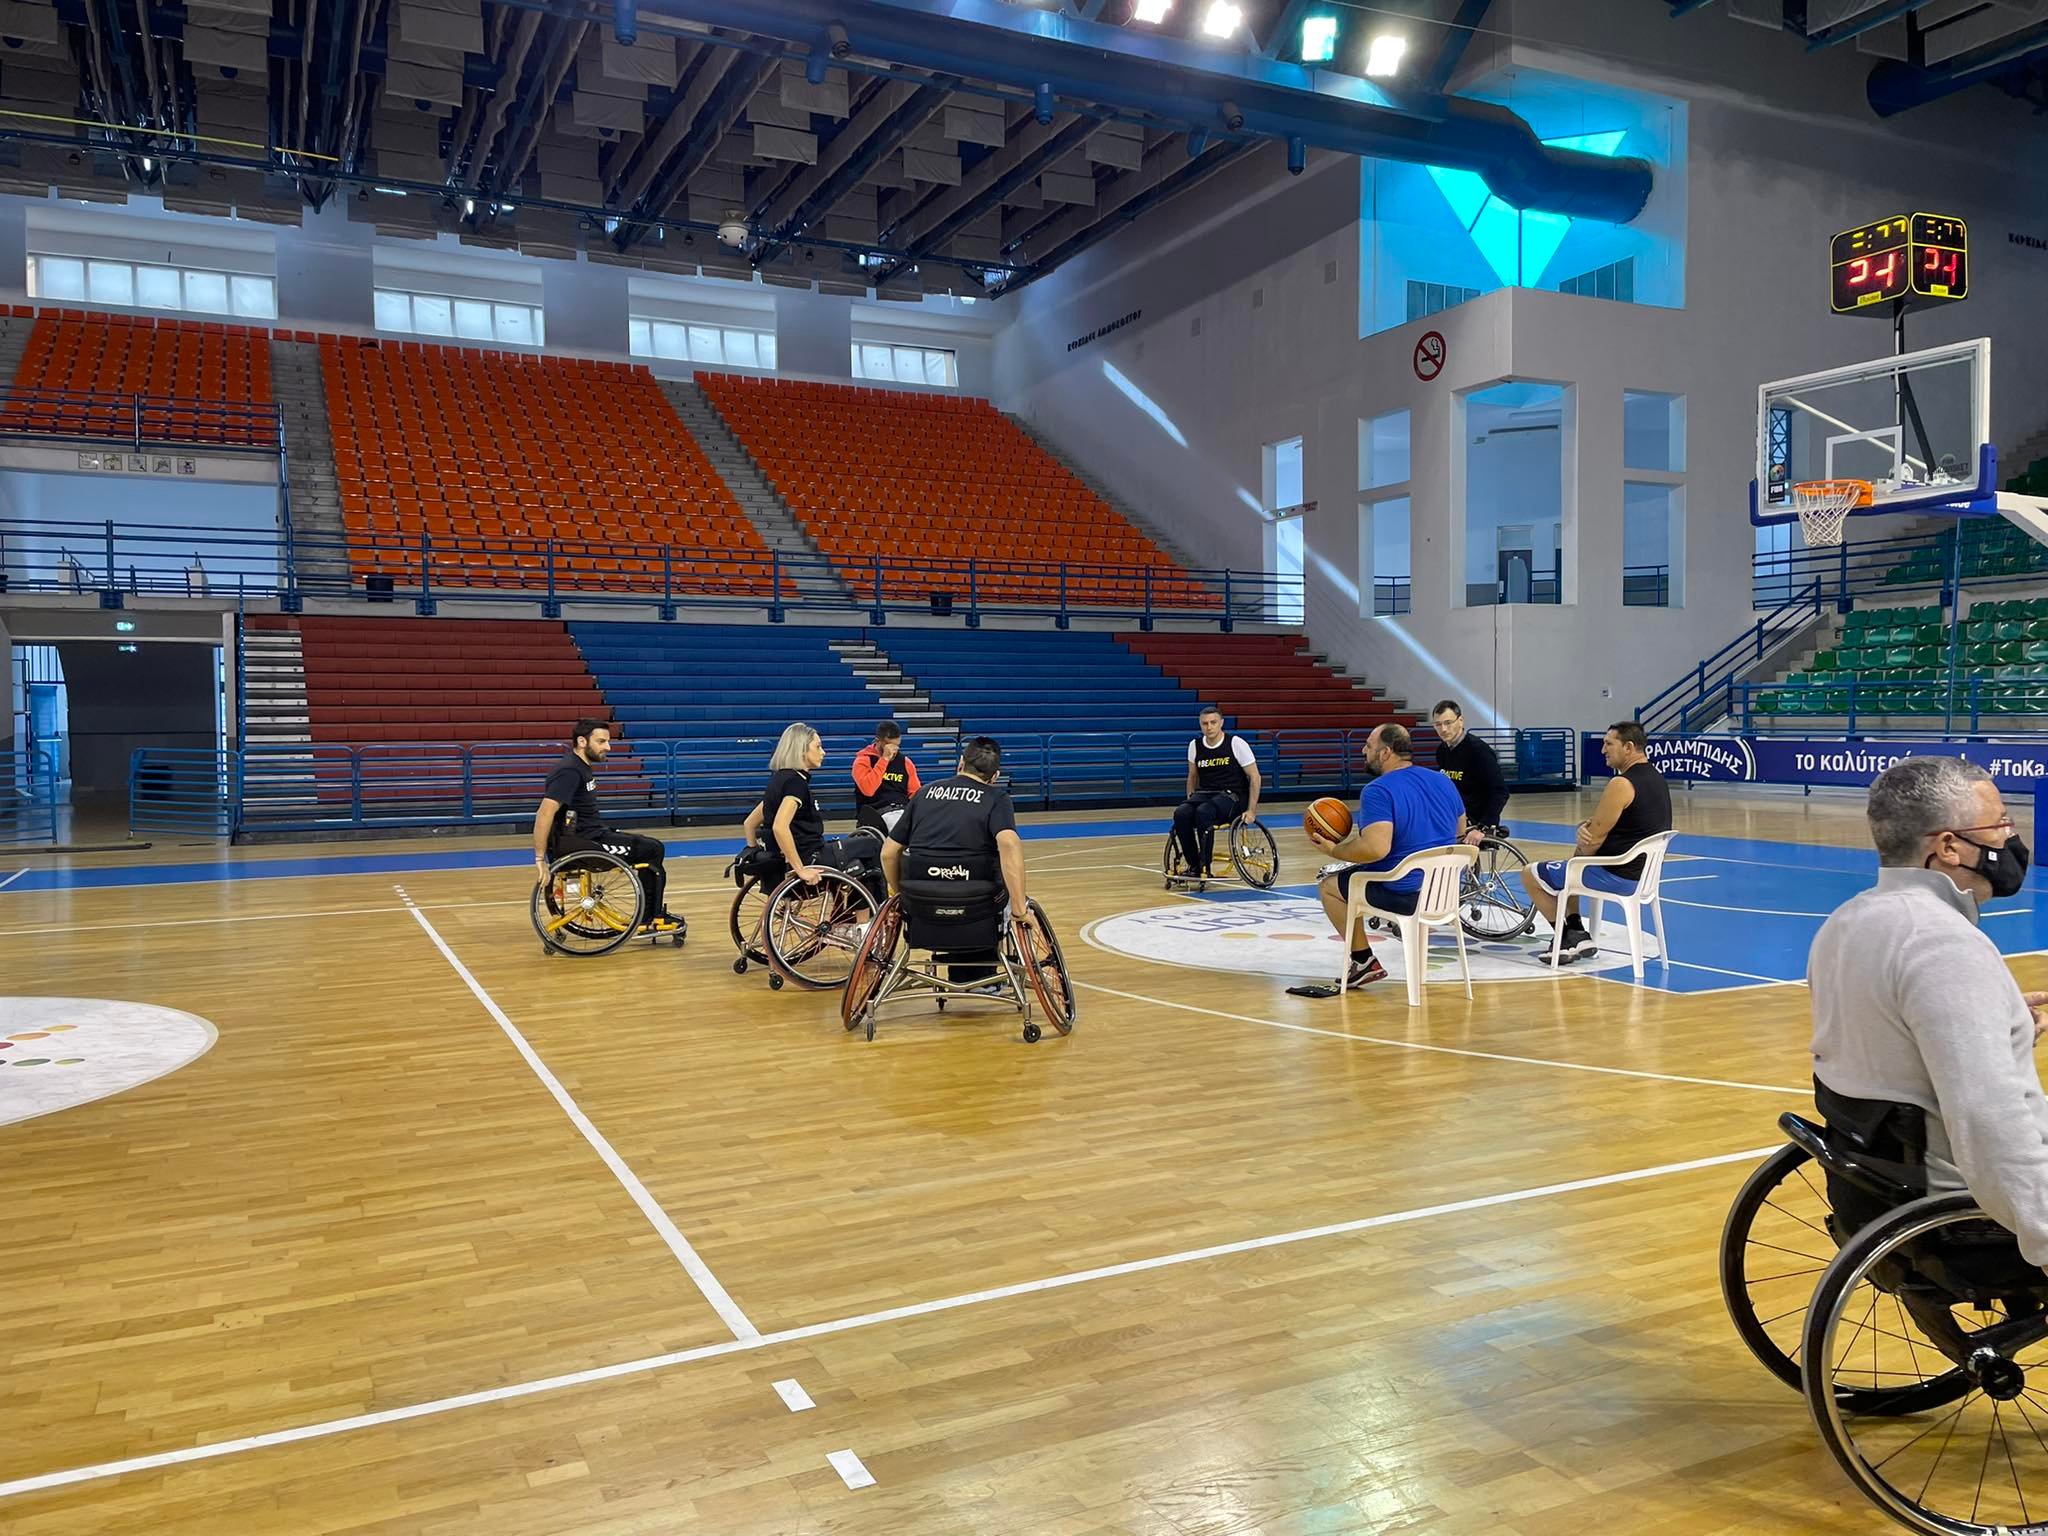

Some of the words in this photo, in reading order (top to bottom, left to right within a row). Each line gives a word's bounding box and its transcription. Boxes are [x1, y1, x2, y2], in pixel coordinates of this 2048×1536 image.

[1645, 740, 1743, 775] ΡΑΛΑΜΠΙΔΗΣ
[1795, 754, 1815, 771] το
[1820, 749, 1911, 773] καλύτε
[925, 786, 985, 803] ΗΦΑΙΣΤΟΣ
